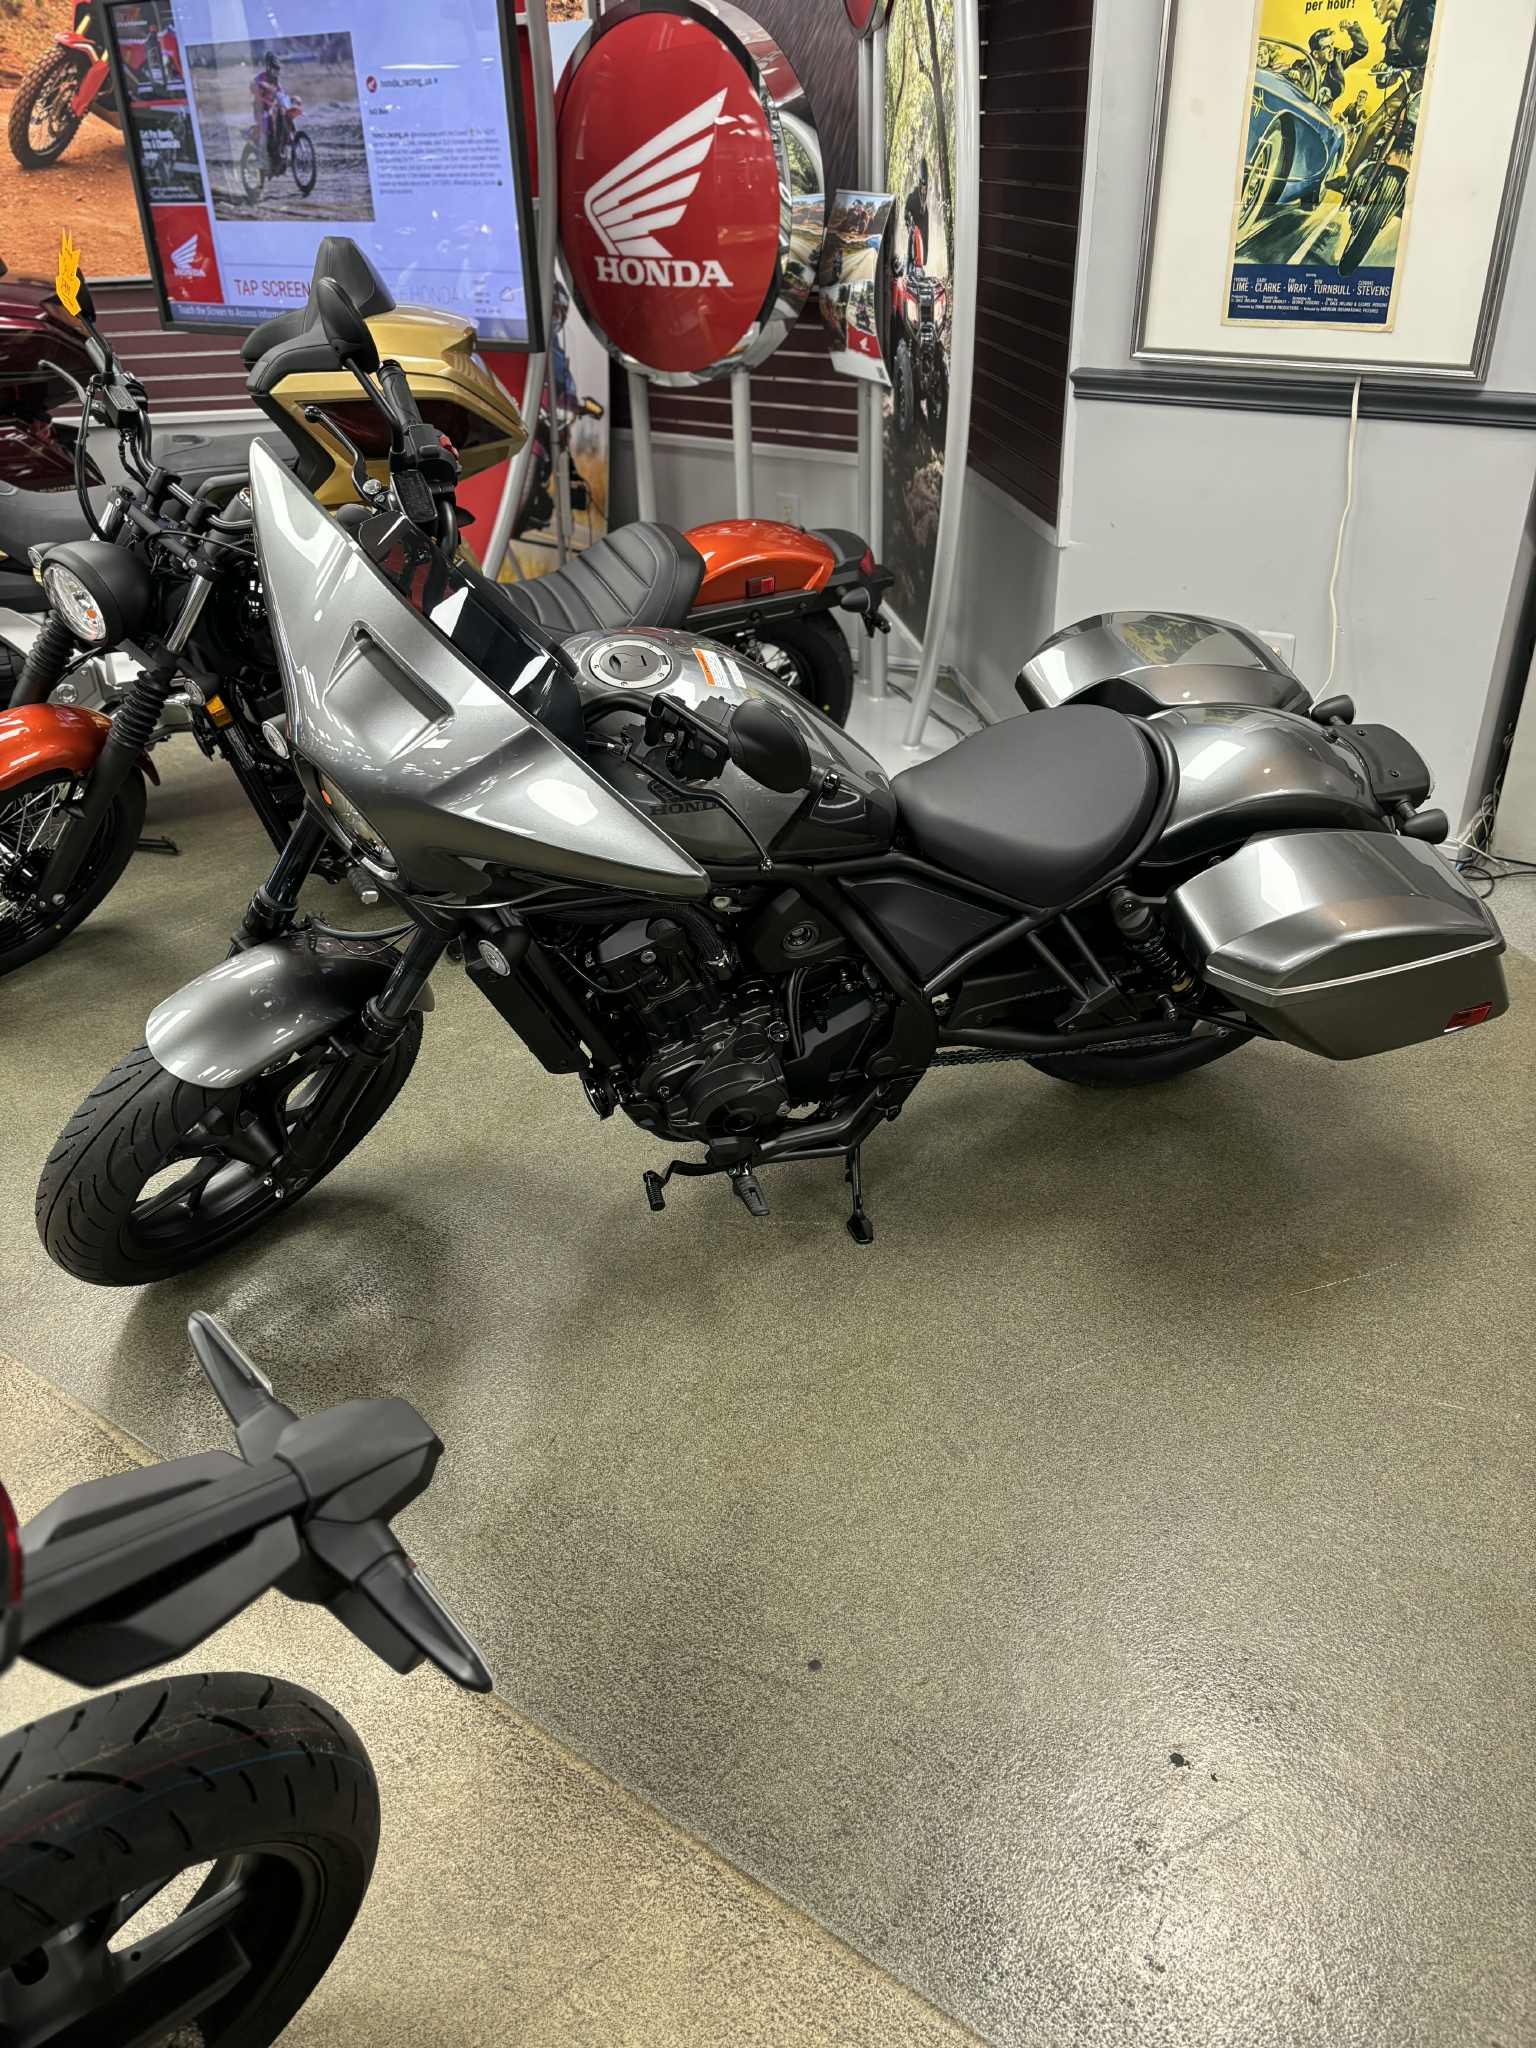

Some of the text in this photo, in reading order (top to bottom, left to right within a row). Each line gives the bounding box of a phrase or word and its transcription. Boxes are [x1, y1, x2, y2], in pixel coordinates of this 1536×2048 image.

[1305, 1, 1323, 14] per
[173, 268, 206, 278] HONDA
[594, 255, 734, 288] HONDA
[234, 279, 311, 298] TAP SCREEN
[1232, 282, 1390, 296] LIME CLARKE WRAY TURNBULL STEVENS
[650, 800, 720, 815] HOND
